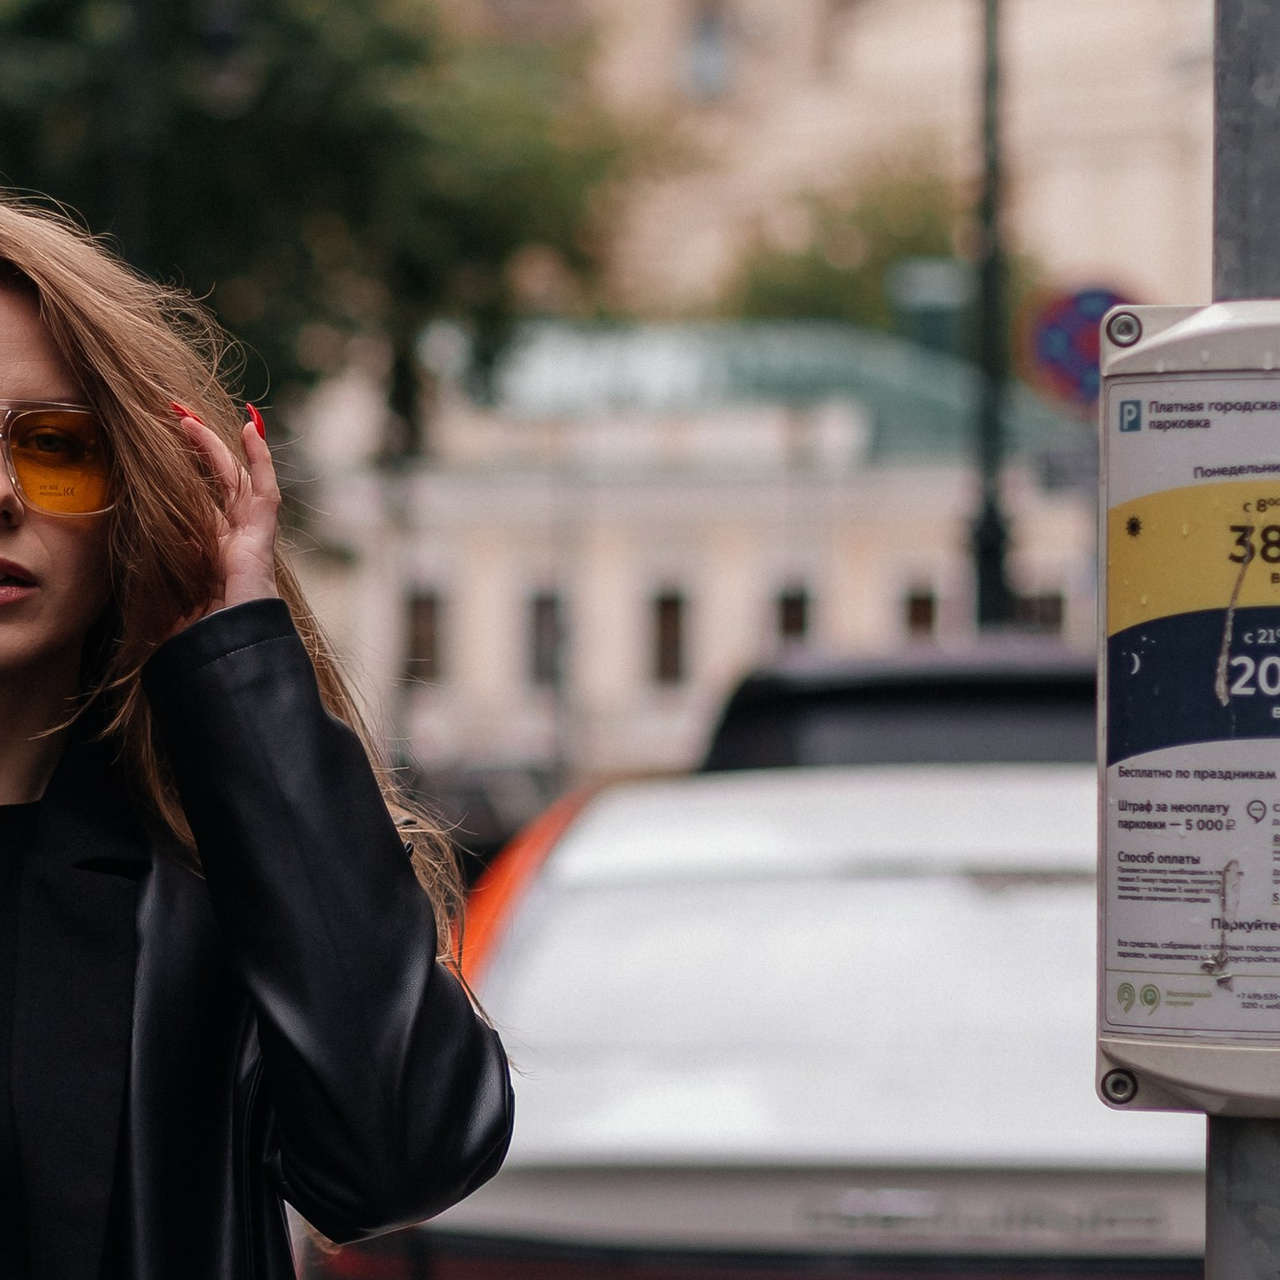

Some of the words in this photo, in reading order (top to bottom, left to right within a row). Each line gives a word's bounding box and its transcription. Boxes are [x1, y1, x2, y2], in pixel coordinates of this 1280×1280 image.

[1149, 401, 1204, 413] Платная
[1149, 419, 1210, 432] парковка
[1118, 766, 1172, 778] Бесплатно
[1175, 770, 1190, 779] по
[1193, 770, 1277, 781] праздникам
[1118, 800, 1153, 814] Штраф
[1155, 804, 1168, 812] за
[1171, 804, 1230, 816] неоплату
[1118, 820, 1167, 832] парковки
[1118, 851, 1154, 864] Способ
[1157, 854, 1200, 865] оплаты
[1211, 918, 1280, 933] Паркуйте
